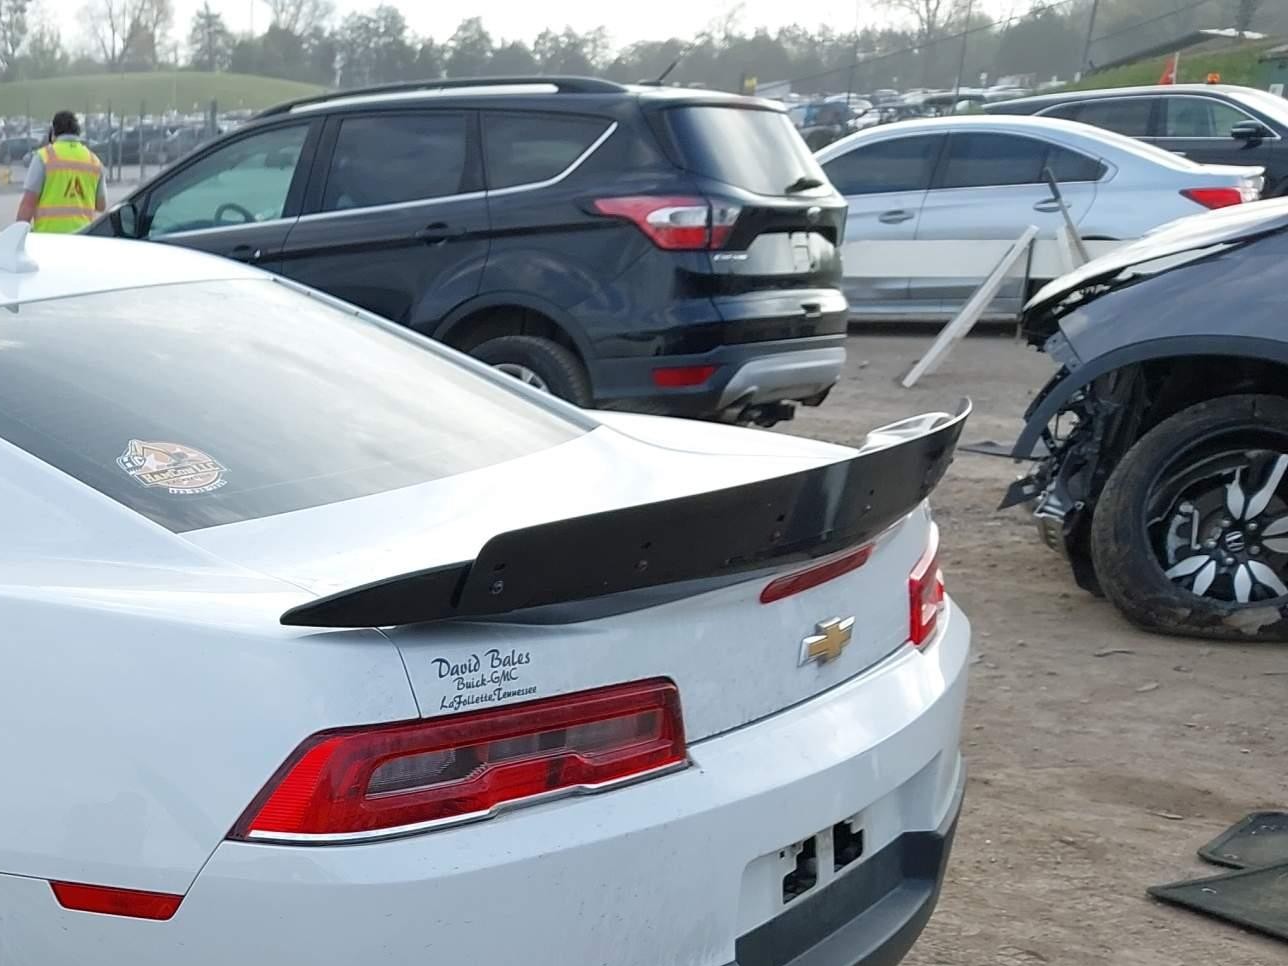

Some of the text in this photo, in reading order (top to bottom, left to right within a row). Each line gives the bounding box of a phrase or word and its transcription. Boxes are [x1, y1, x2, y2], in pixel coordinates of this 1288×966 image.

[431, 649, 531, 679] David Bales
[453, 668, 519, 691] Buick-GMC
